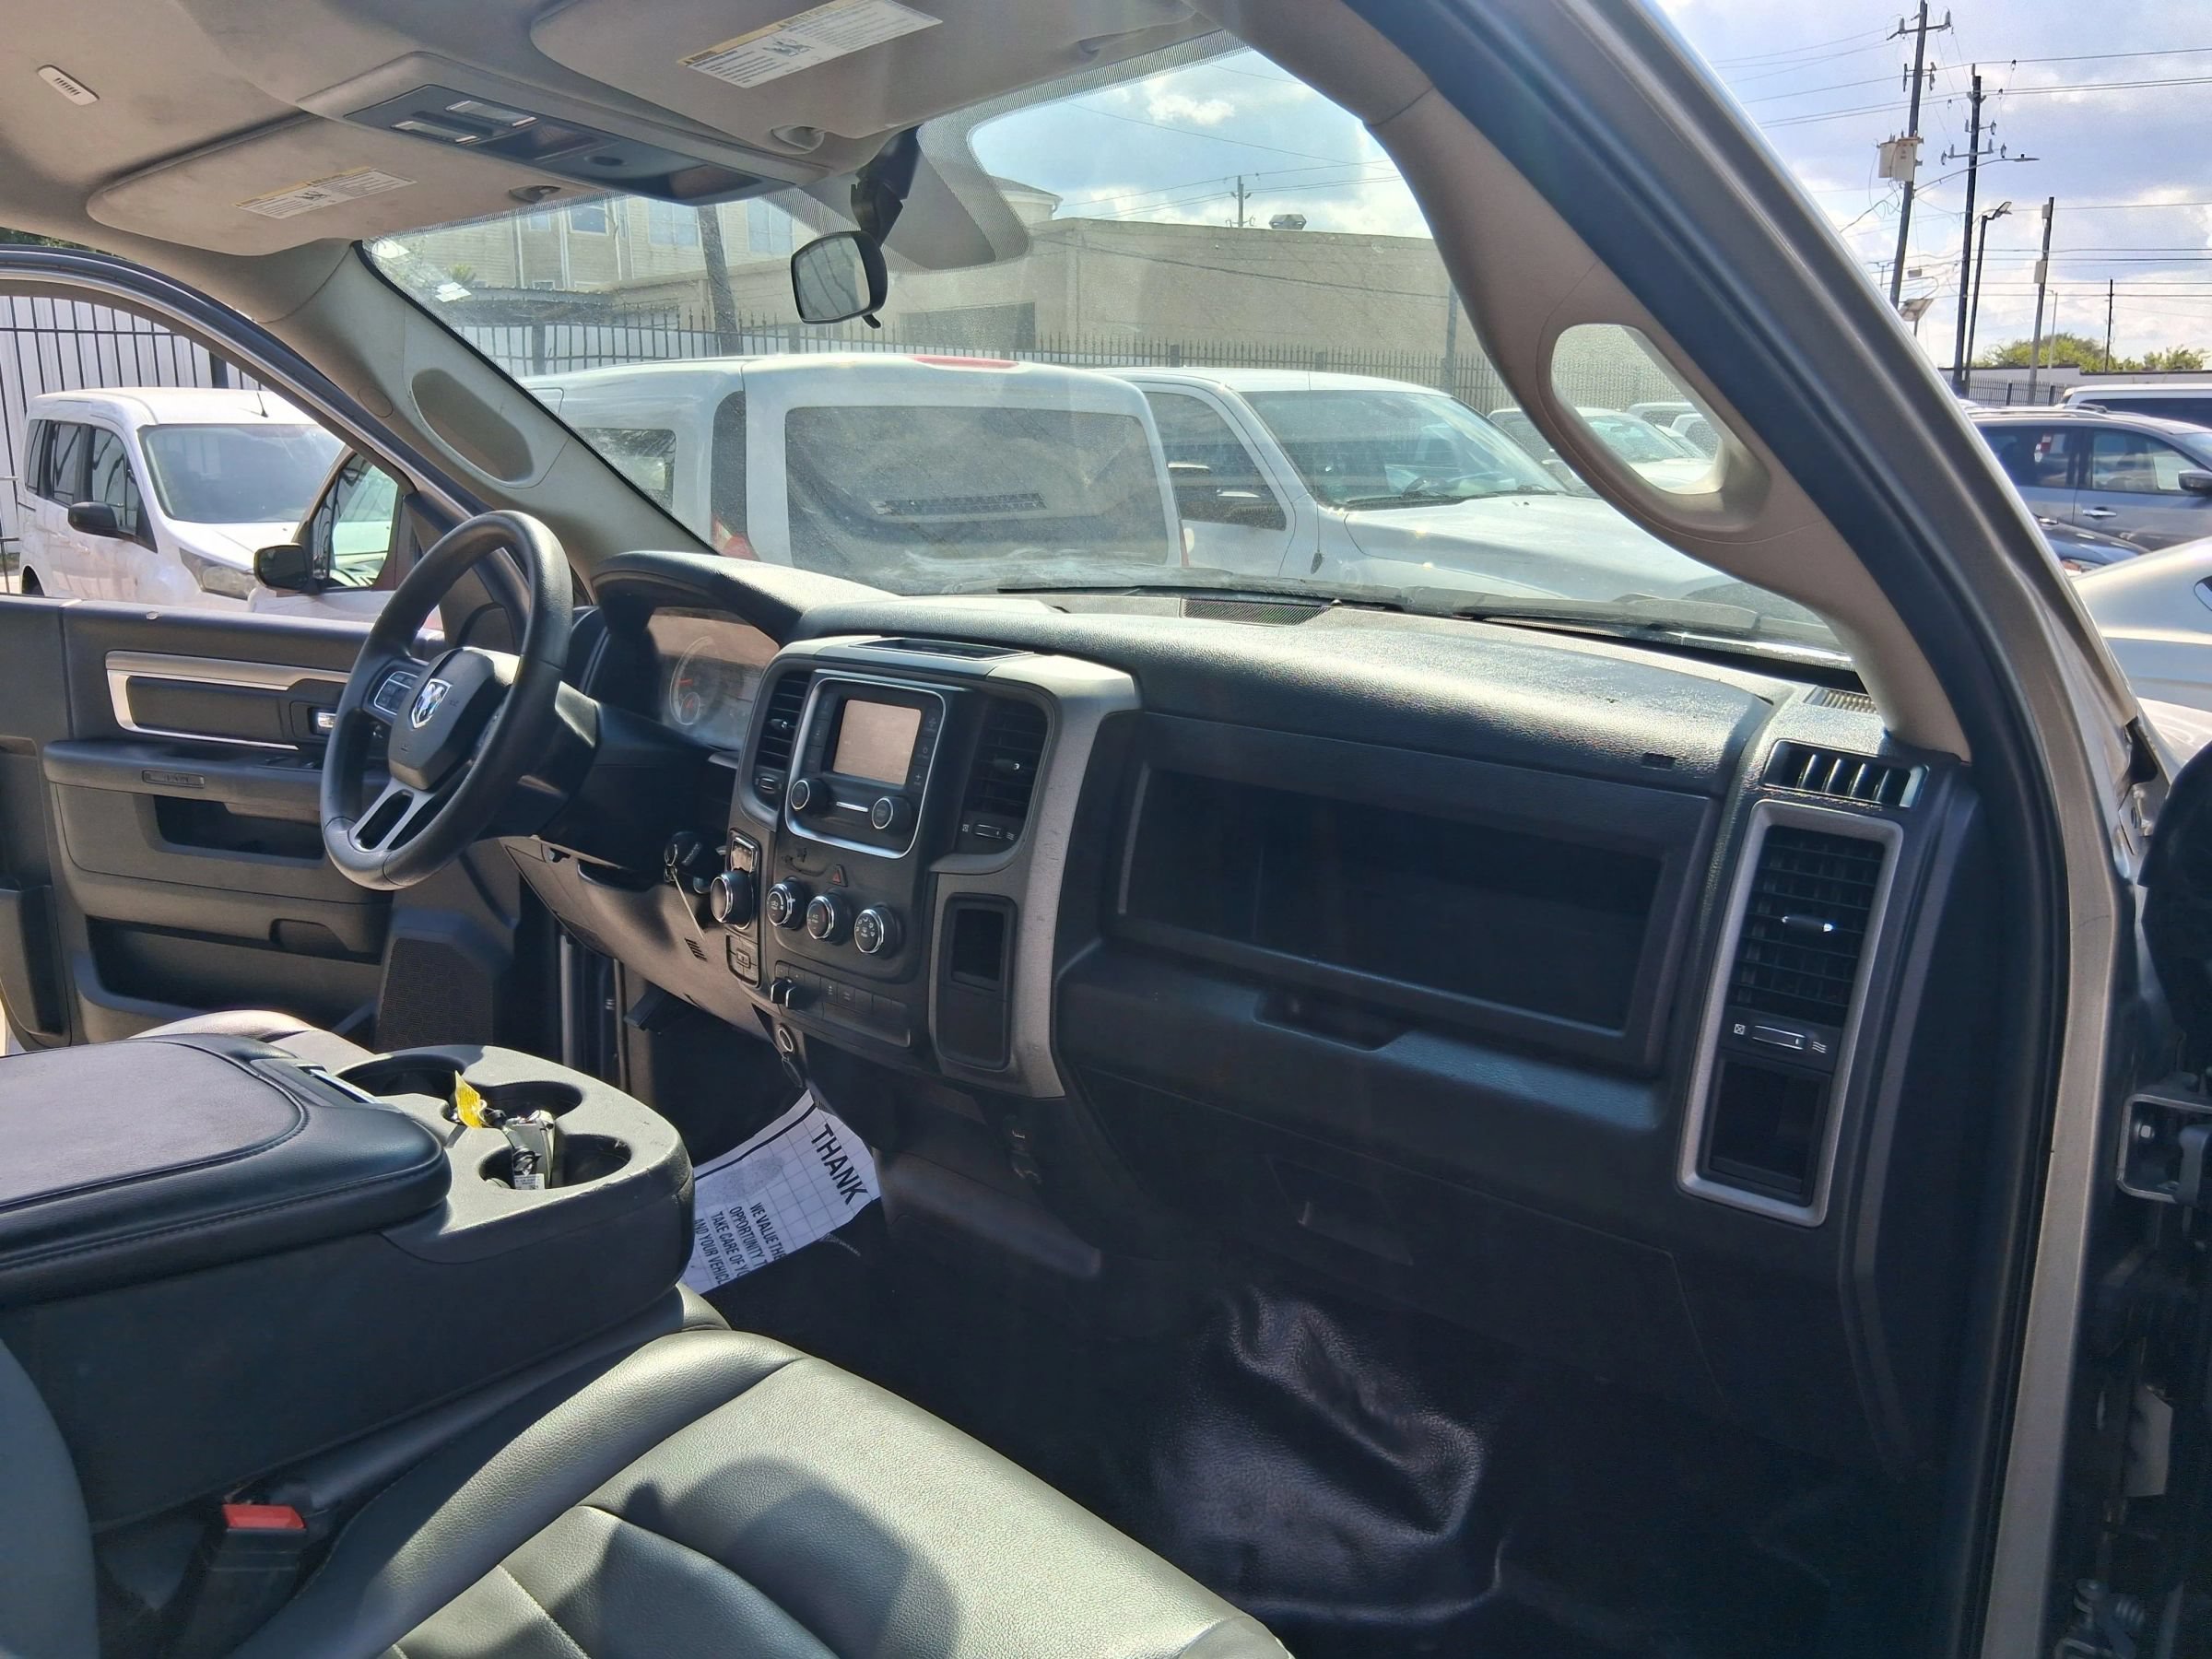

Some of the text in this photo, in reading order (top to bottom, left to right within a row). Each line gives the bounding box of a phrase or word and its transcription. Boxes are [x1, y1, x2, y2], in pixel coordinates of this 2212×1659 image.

[811, 1124, 868, 1206] THANK
[711, 1210, 730, 1233] TAKE
[750, 1202, 766, 1218] WE
[693, 1218, 710, 1234] AND
[729, 1206, 765, 1259] OPPORTUNITY
[756, 1215, 780, 1244] VALUE
[699, 1233, 719, 1257] YOUR
[719, 1232, 740, 1255] CARE
[729, 1253, 746, 1265] OF
